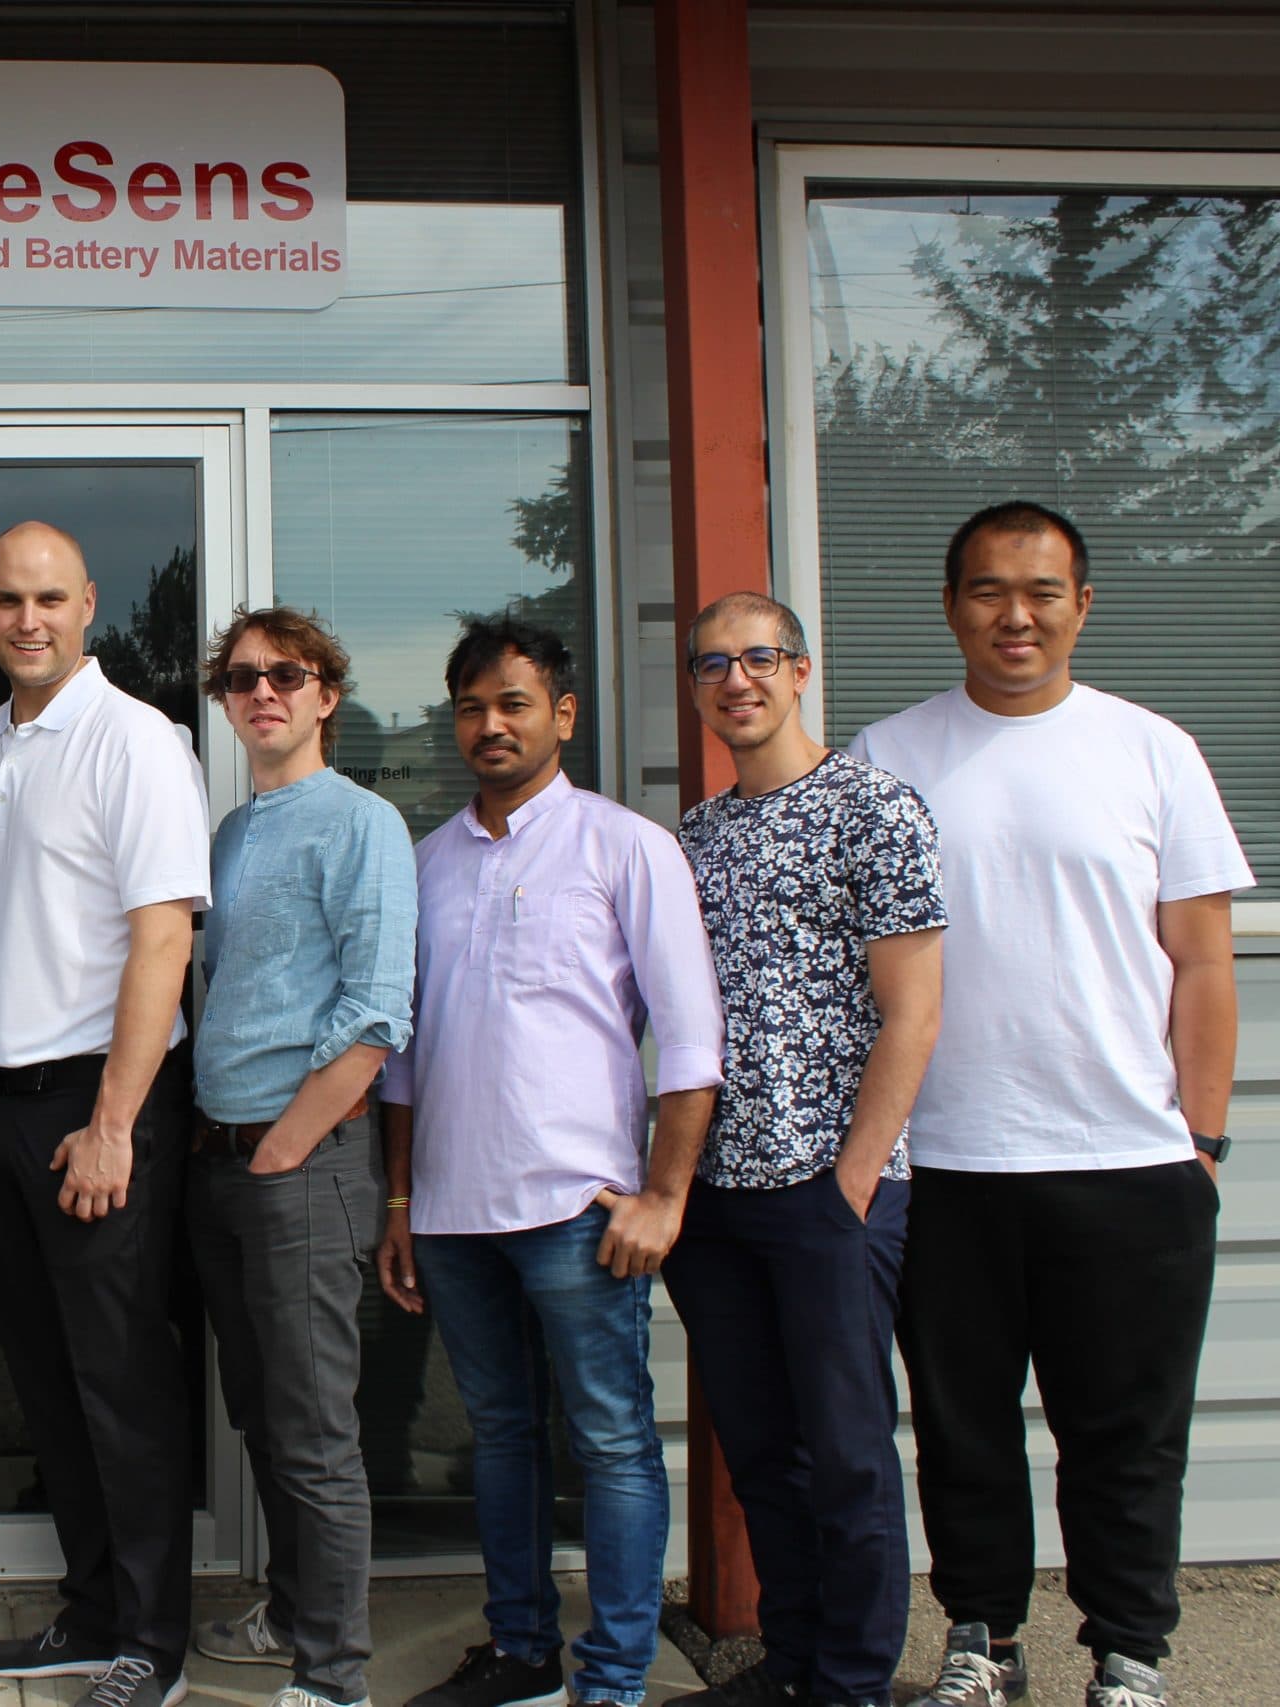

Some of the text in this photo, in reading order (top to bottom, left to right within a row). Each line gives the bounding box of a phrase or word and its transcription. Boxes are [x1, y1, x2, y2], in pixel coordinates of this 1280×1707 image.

[25, 237, 160, 279] Battery
[174, 240, 341, 274] Materials
[343, 765, 410, 783] Ring Bell
